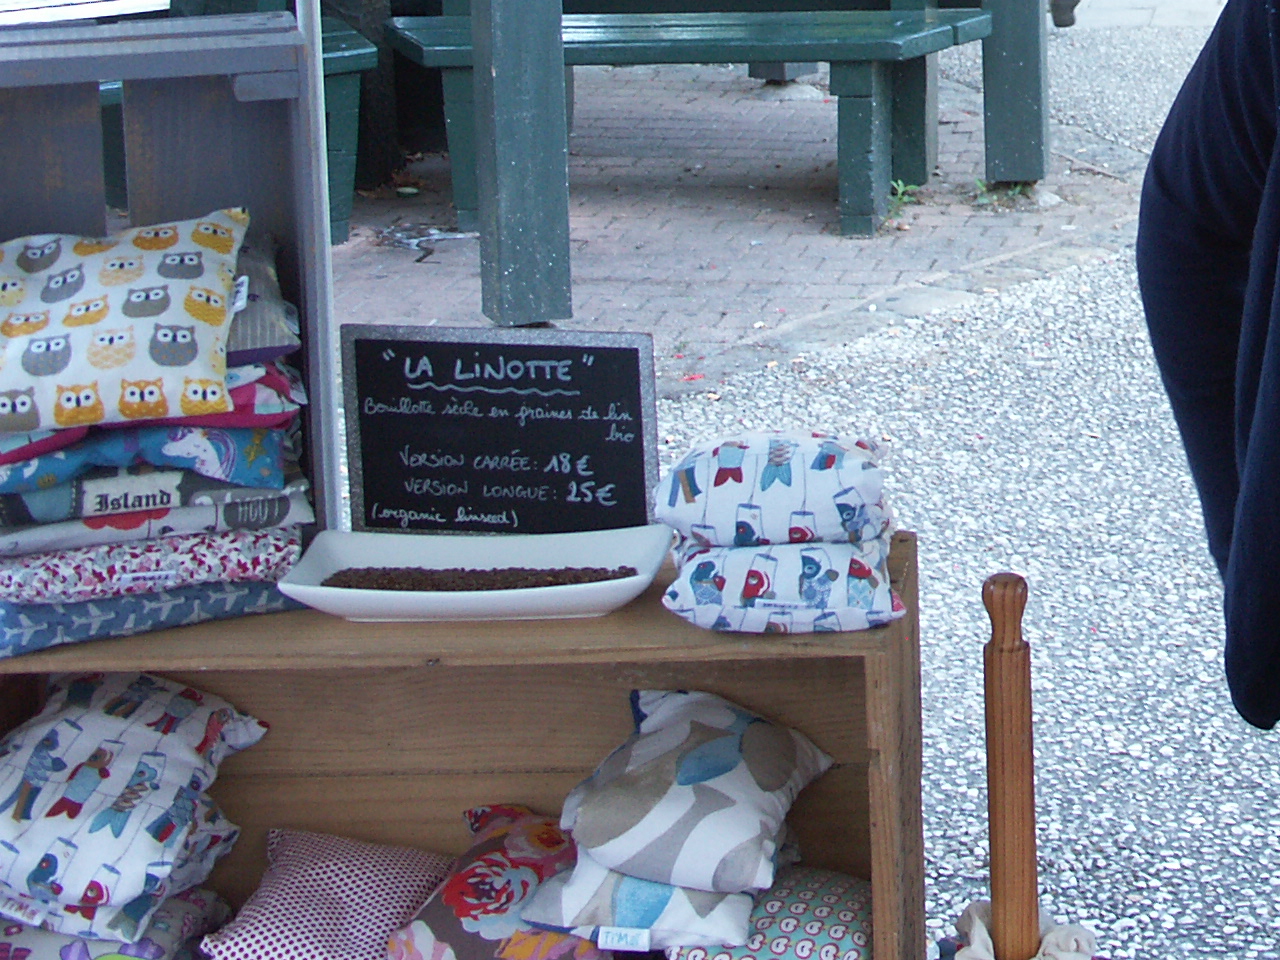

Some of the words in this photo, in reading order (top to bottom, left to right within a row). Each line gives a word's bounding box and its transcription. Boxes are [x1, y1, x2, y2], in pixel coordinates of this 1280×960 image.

[489, 406, 509, 417] en
[514, 404, 573, 427] graines
[578, 406, 599, 420] de
[603, 403, 633, 421] lin
[605, 423, 635, 442] bio
[94, 490, 171, 512] Island
